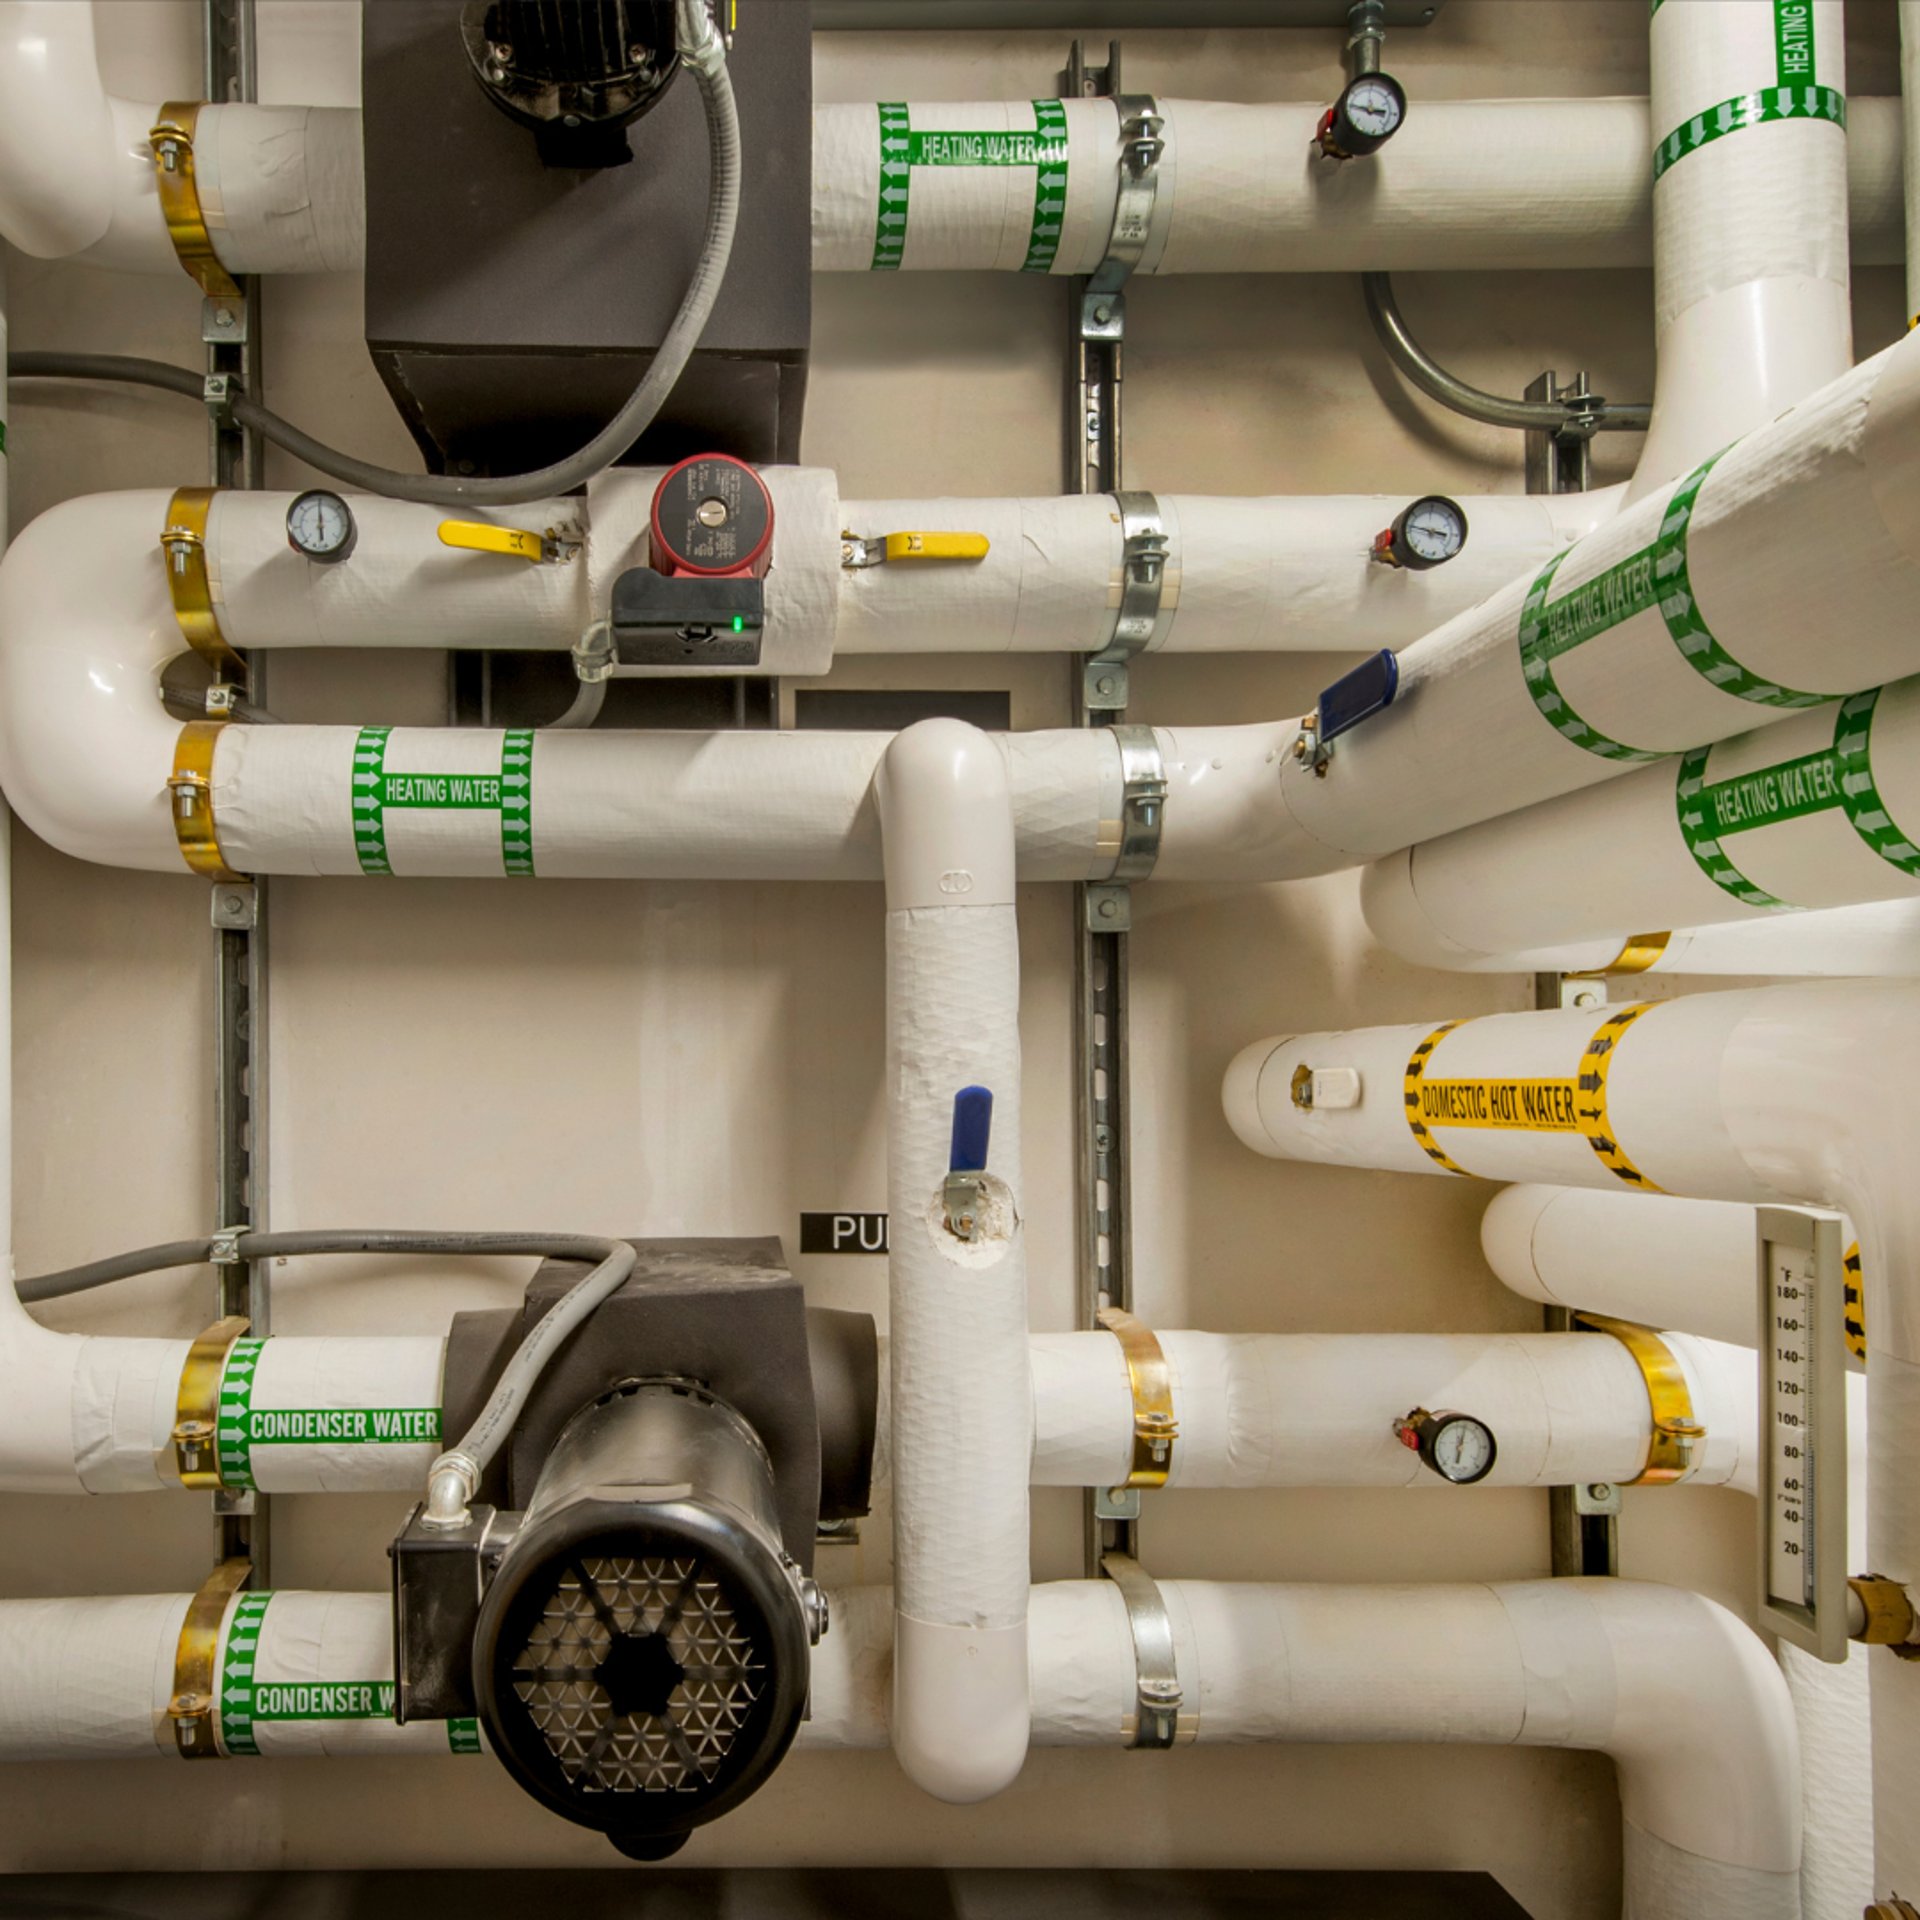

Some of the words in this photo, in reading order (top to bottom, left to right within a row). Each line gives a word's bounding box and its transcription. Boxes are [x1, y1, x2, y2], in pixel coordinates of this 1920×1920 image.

[1781, 5, 1809, 74] HEATING
[922, 136, 982, 160] HEATING
[985, 136, 1036, 161] WATER
[1548, 586, 1601, 647] HEATING
[1603, 556, 1653, 617] WATER
[386, 778, 447, 802] HEATING
[449, 779, 501, 803] WATER
[1713, 776, 1779, 826] HEATING
[1777, 758, 1840, 809] WATER
[1423, 1085, 1487, 1119] DOMESTIC
[1490, 1085, 1519, 1121] HOT
[1521, 1085, 1578, 1124] WATER
[833, 1216, 889, 1250] PU
[1777, 1285, 1798, 1300] 180
[1777, 1316, 1798, 1331] 160
[1777, 1348, 1798, 1363] 140
[1777, 1380, 1798, 1395] 120
[250, 1412, 367, 1439] CONDENSER
[372, 1411, 438, 1437] WATER
[1777, 1411, 1798, 1427] 100
[1784, 1445, 1799, 1459] 80
[1784, 1477, 1799, 1491] 60
[1784, 1509, 1799, 1523] 40
[1784, 1541, 1799, 1555] 20
[255, 1686, 373, 1714] CONDENSER
